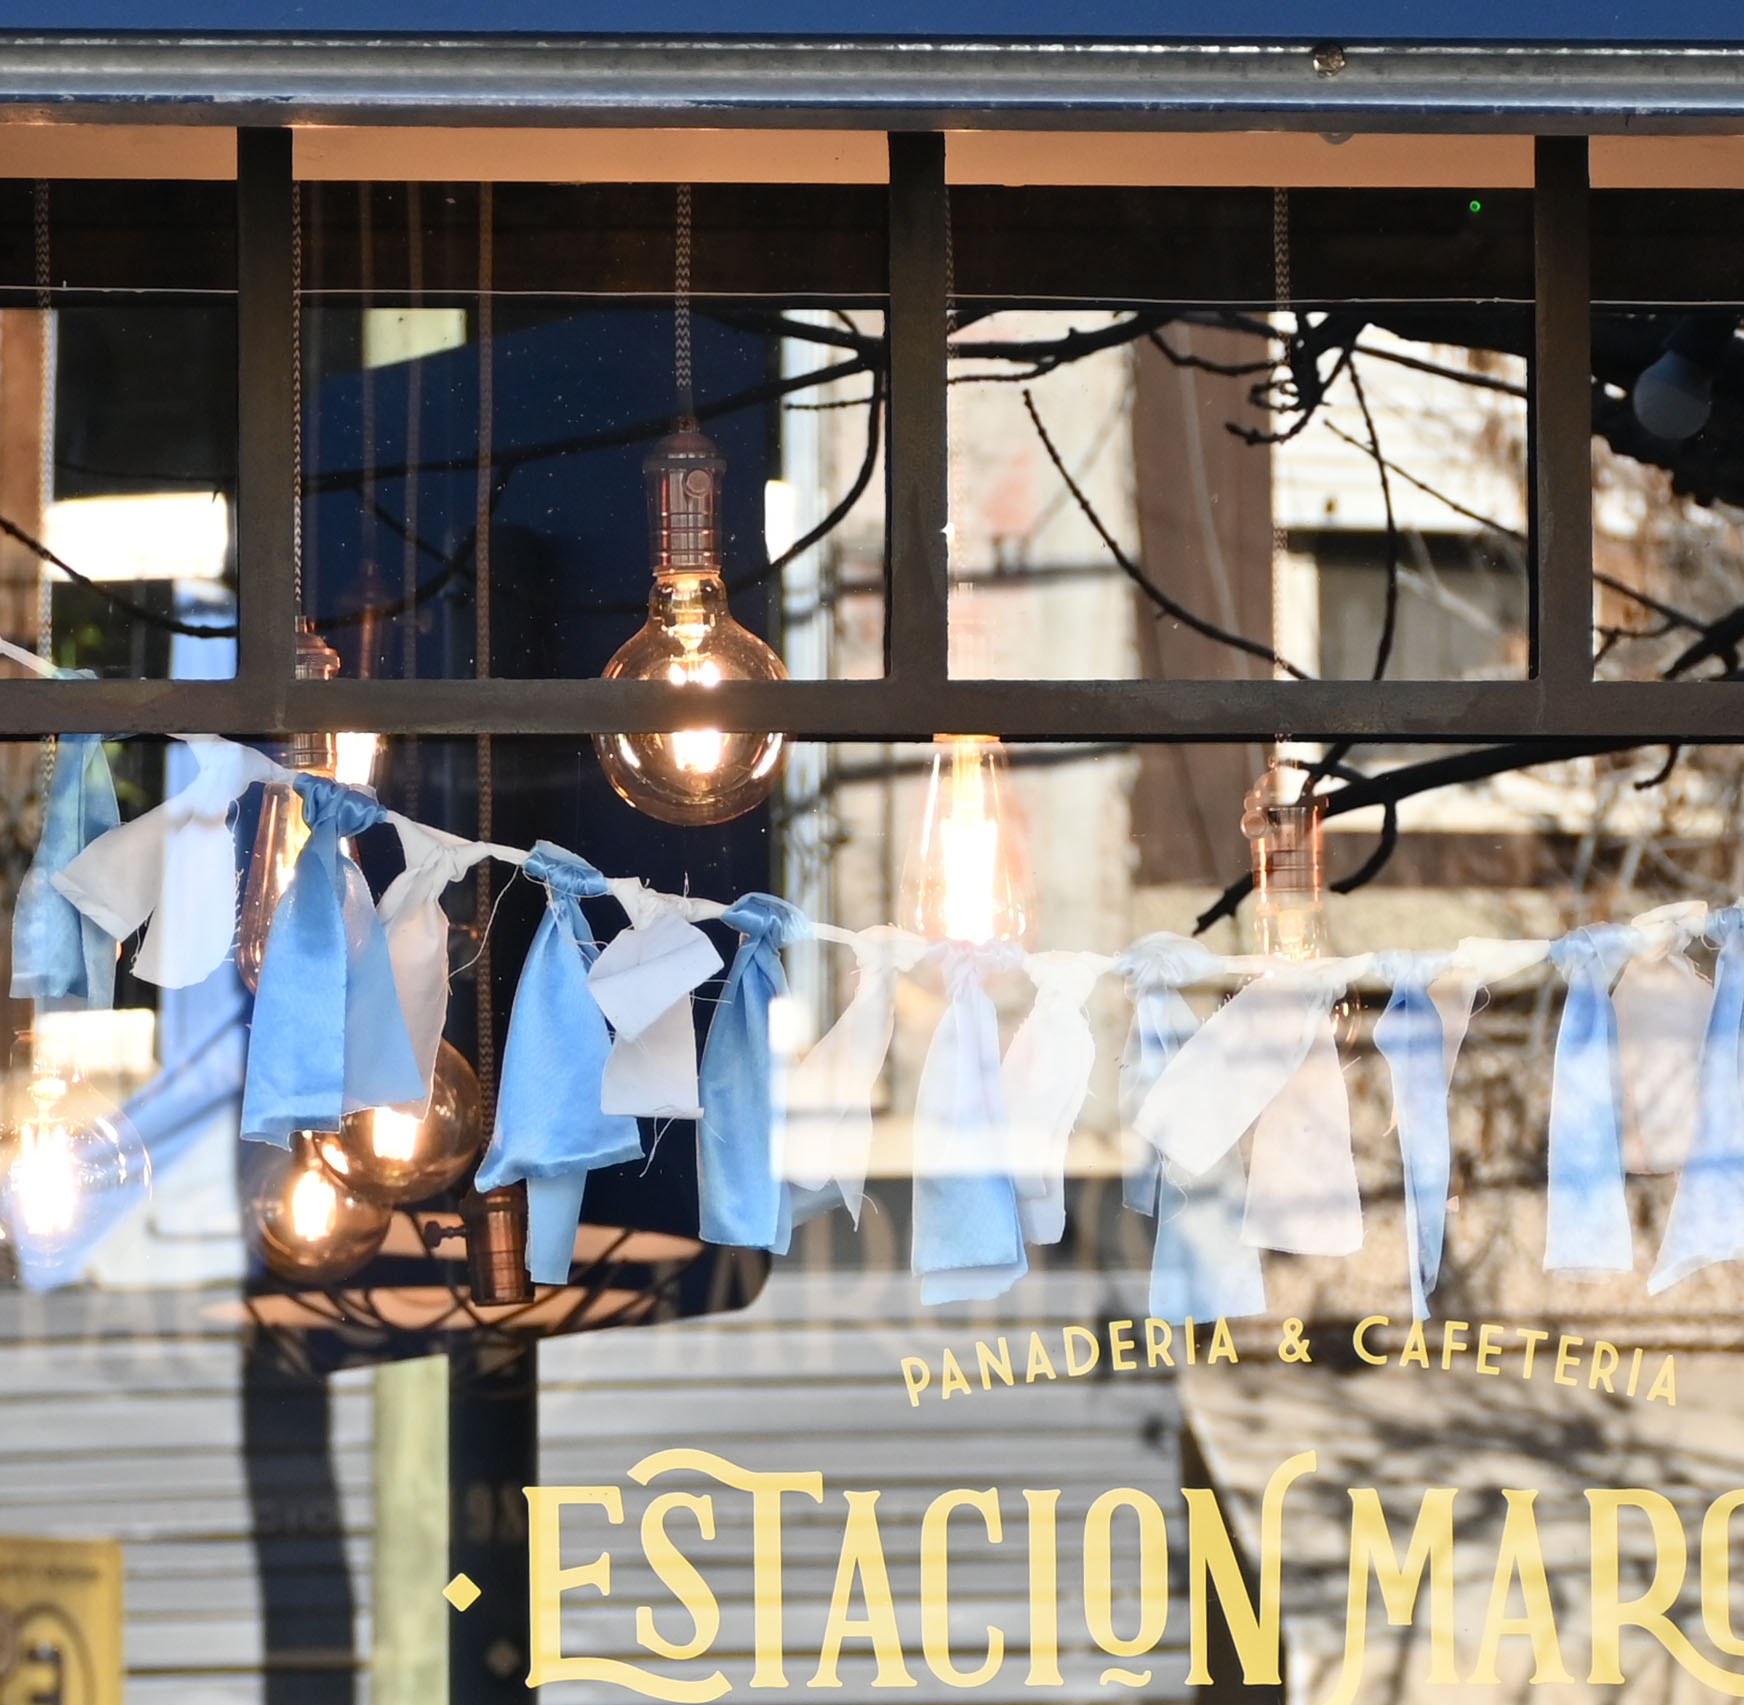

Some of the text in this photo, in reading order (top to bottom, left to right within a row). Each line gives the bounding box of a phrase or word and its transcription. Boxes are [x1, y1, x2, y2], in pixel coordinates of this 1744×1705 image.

[901, 1314, 1678, 1407] PANADERIA & CAFETERIA
[524, 1448, 1317, 1704] ESTACION
